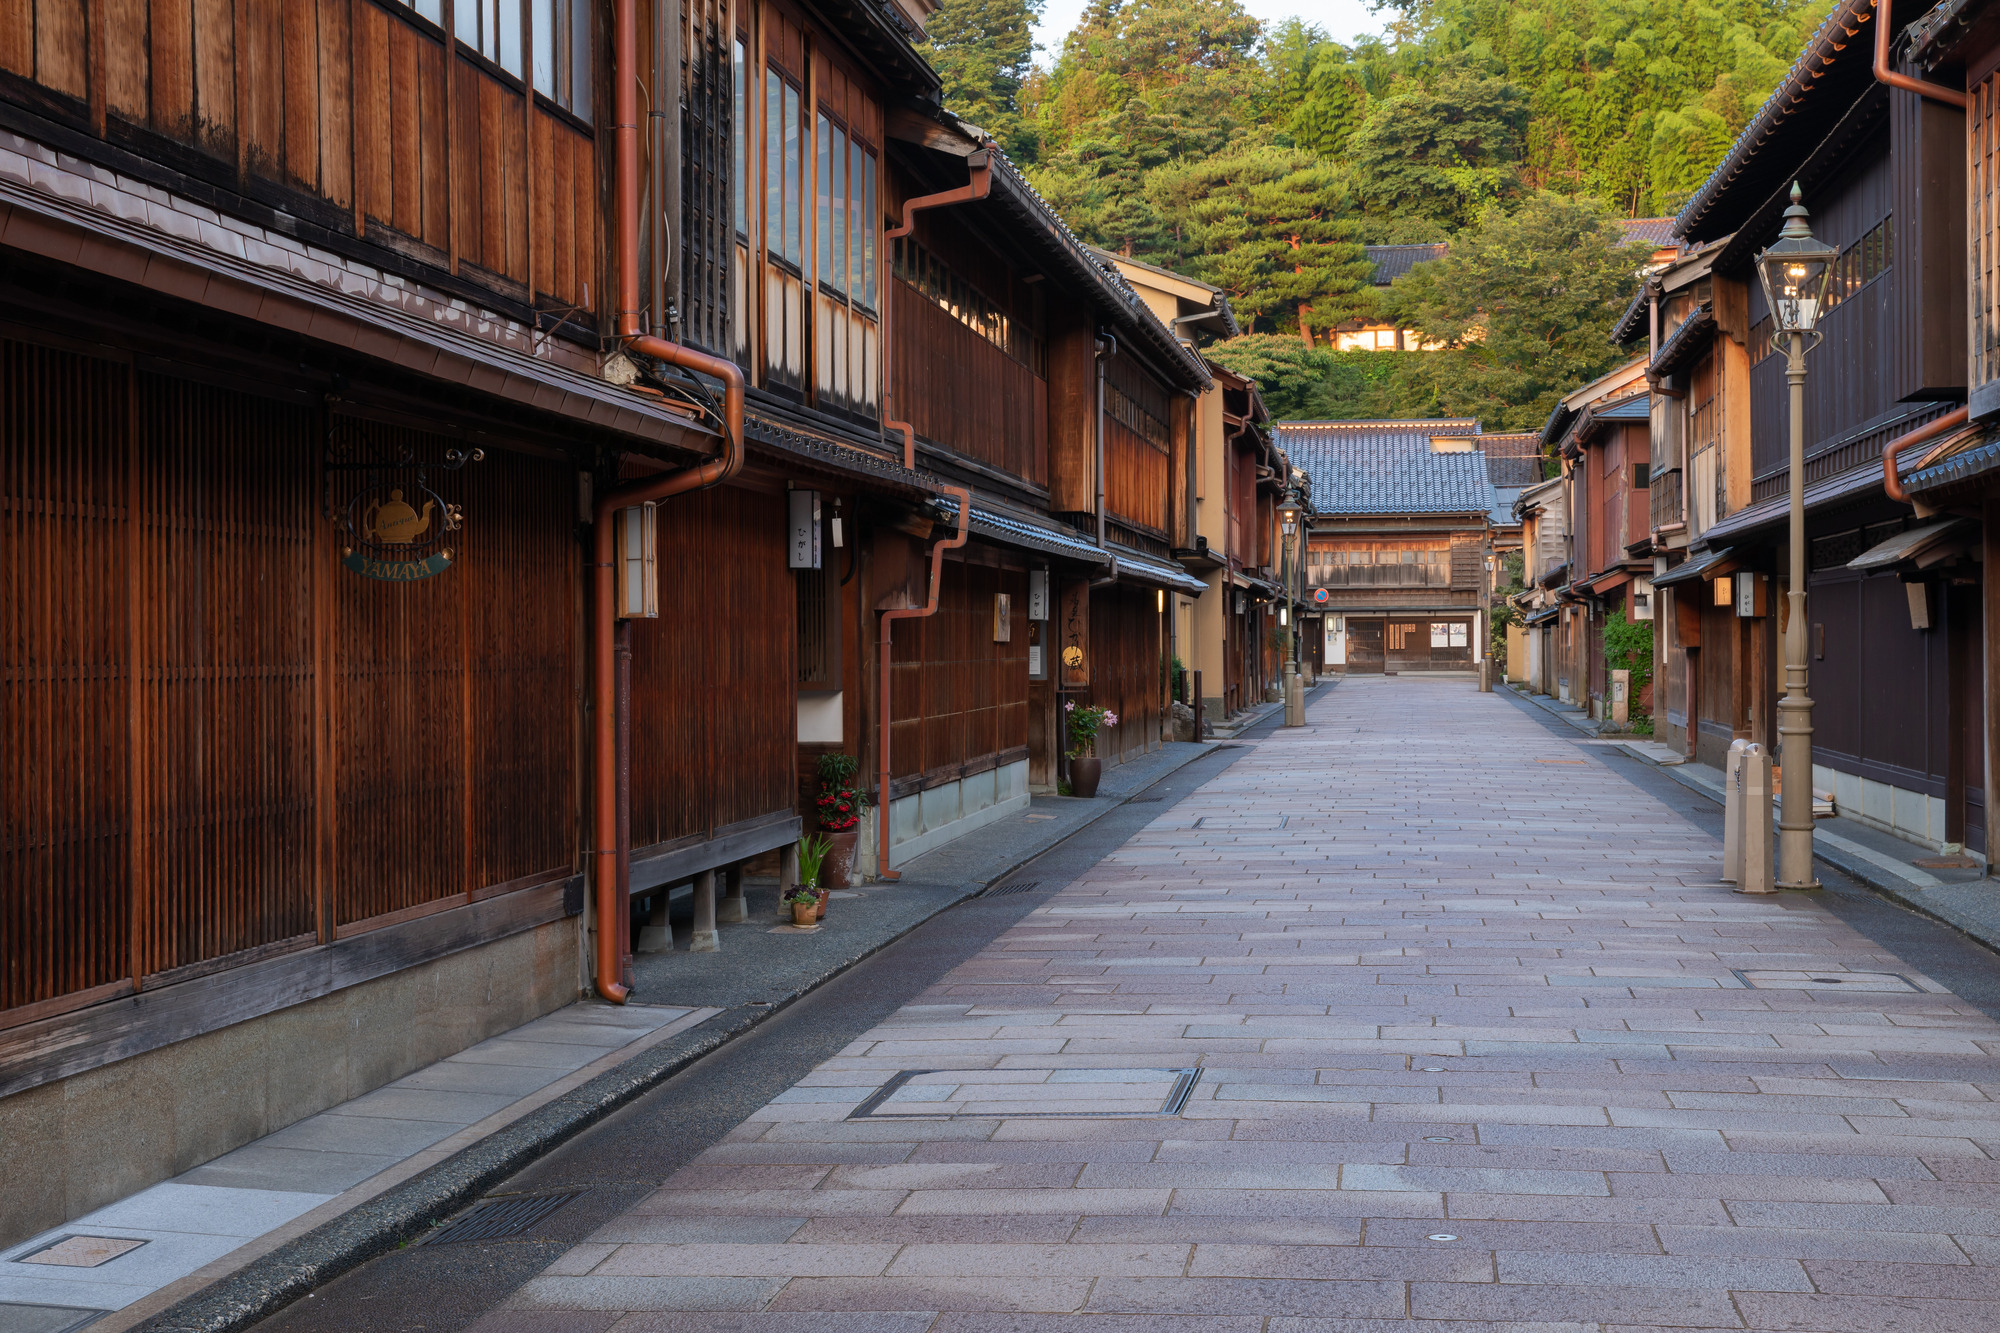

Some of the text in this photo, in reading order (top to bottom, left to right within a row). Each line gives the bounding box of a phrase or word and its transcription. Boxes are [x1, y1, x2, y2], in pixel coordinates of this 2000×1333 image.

[797, 528, 806, 561] ひがし
[361, 558, 432, 580] YAMAYA
